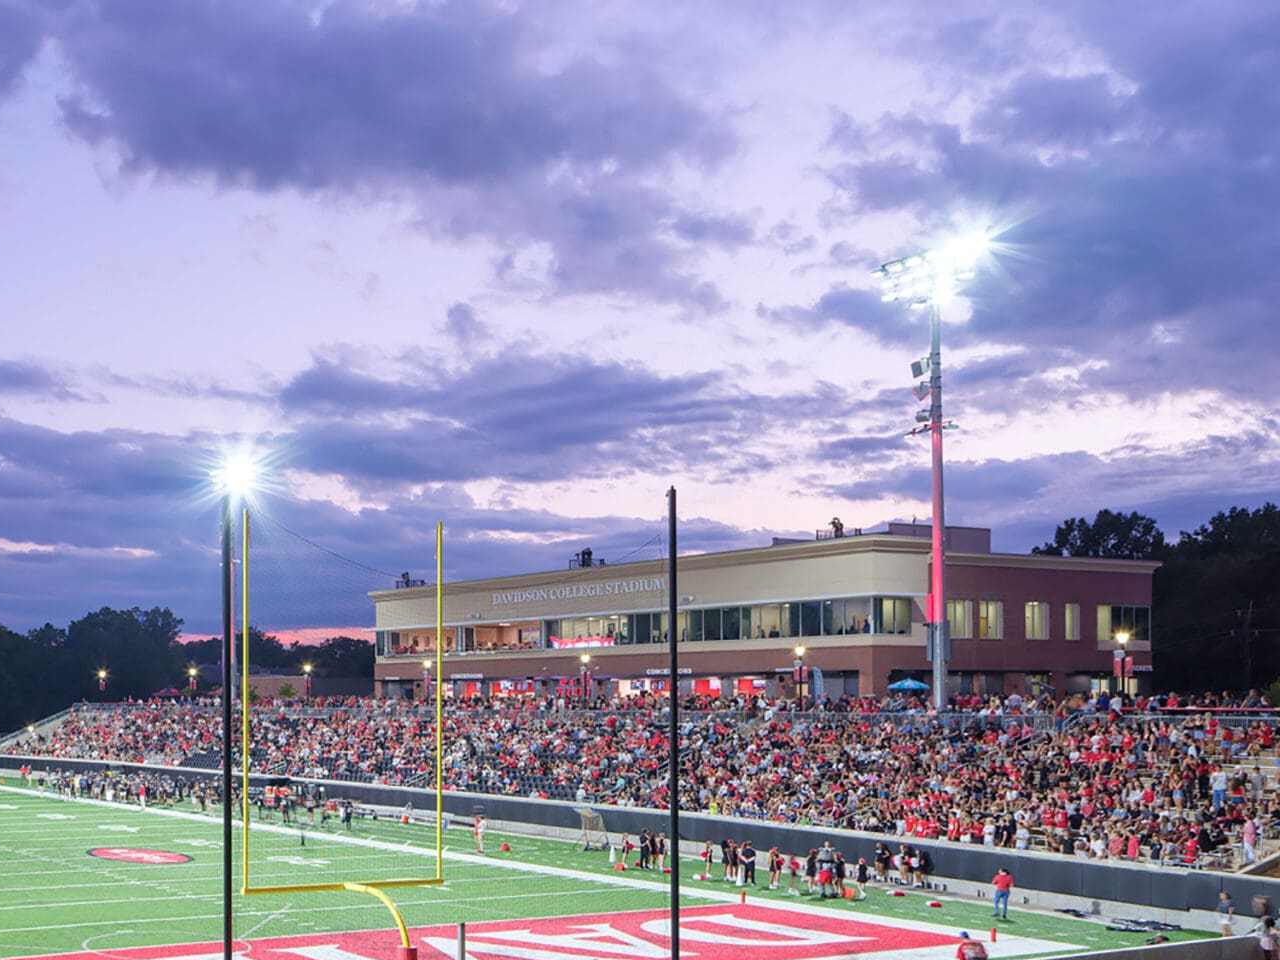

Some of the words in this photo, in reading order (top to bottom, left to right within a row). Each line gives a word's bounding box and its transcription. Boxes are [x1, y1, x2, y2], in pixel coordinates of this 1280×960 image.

[492, 589, 547, 605] DAVIDSON
[549, 583, 603, 600] COLLEGE
[604, 577, 666, 596] STADIUM
